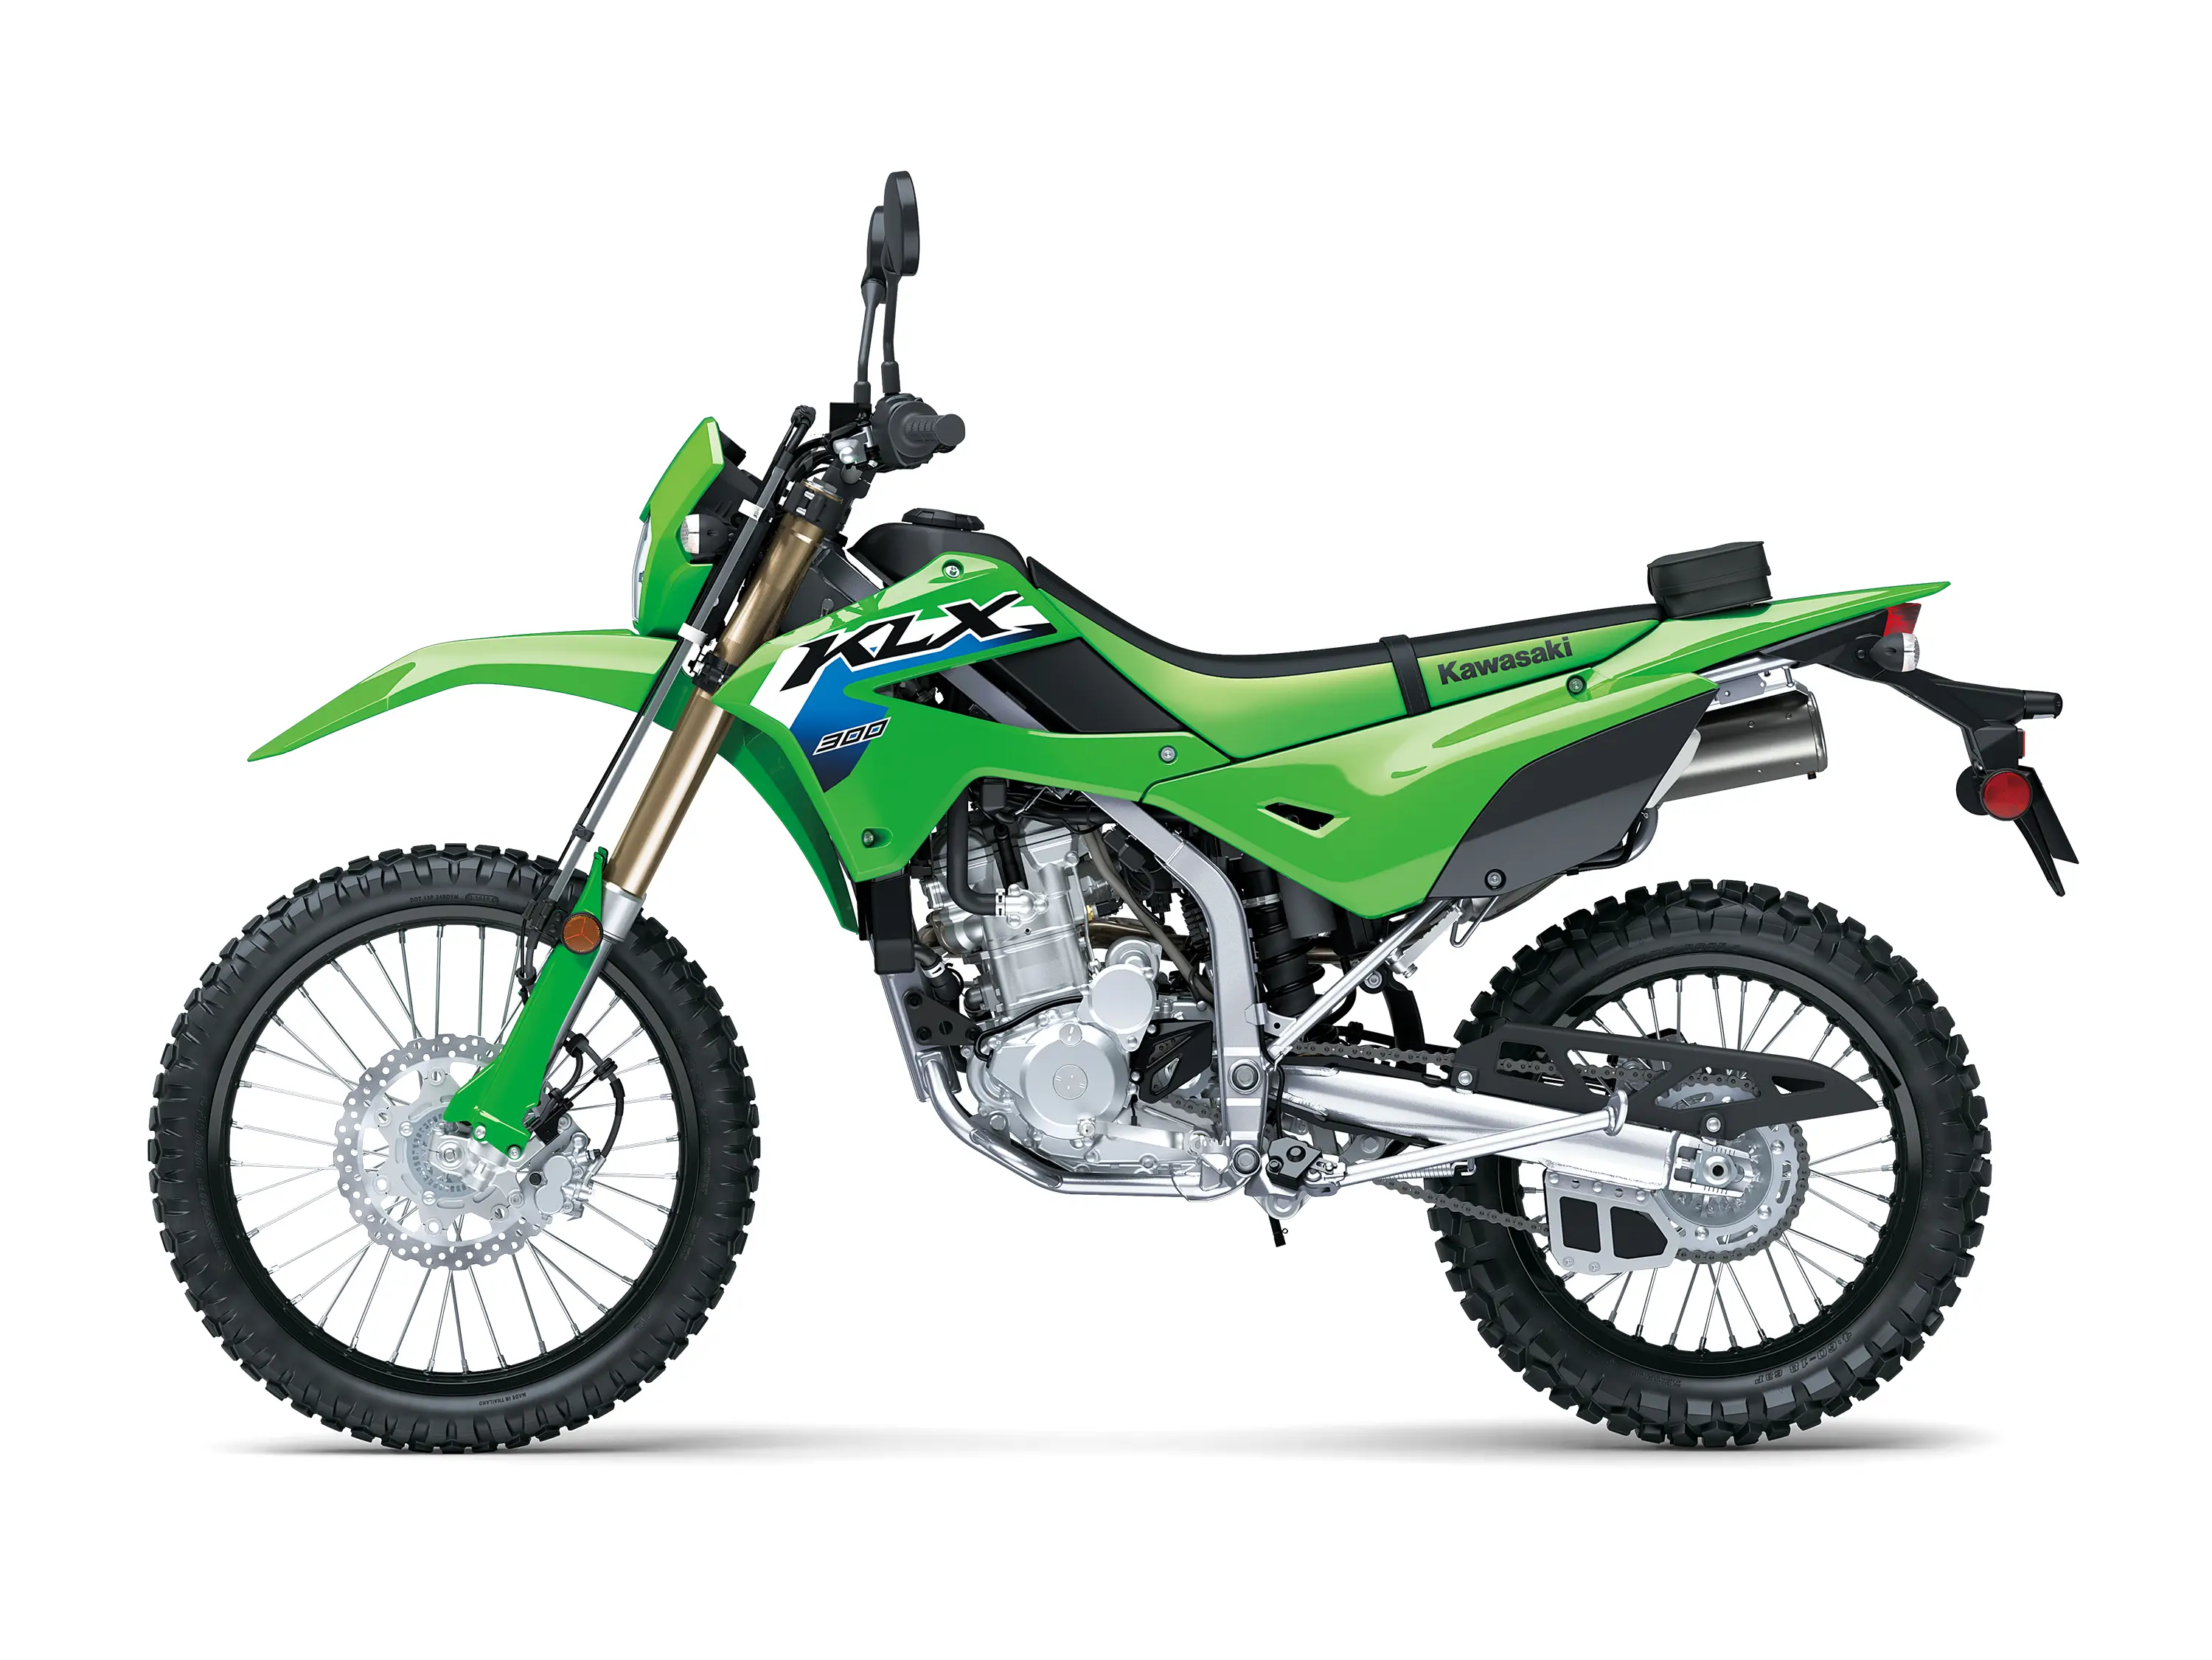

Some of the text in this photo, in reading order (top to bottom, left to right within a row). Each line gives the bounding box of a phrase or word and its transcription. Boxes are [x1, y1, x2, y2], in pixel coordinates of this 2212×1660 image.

[779, 592, 1023, 691] KLX
[1438, 636, 1573, 685] Kawasaki
[815, 718, 890, 754] 300
[479, 1398, 504, 1406] THAILAND
[512, 1392, 526, 1401] MADE
